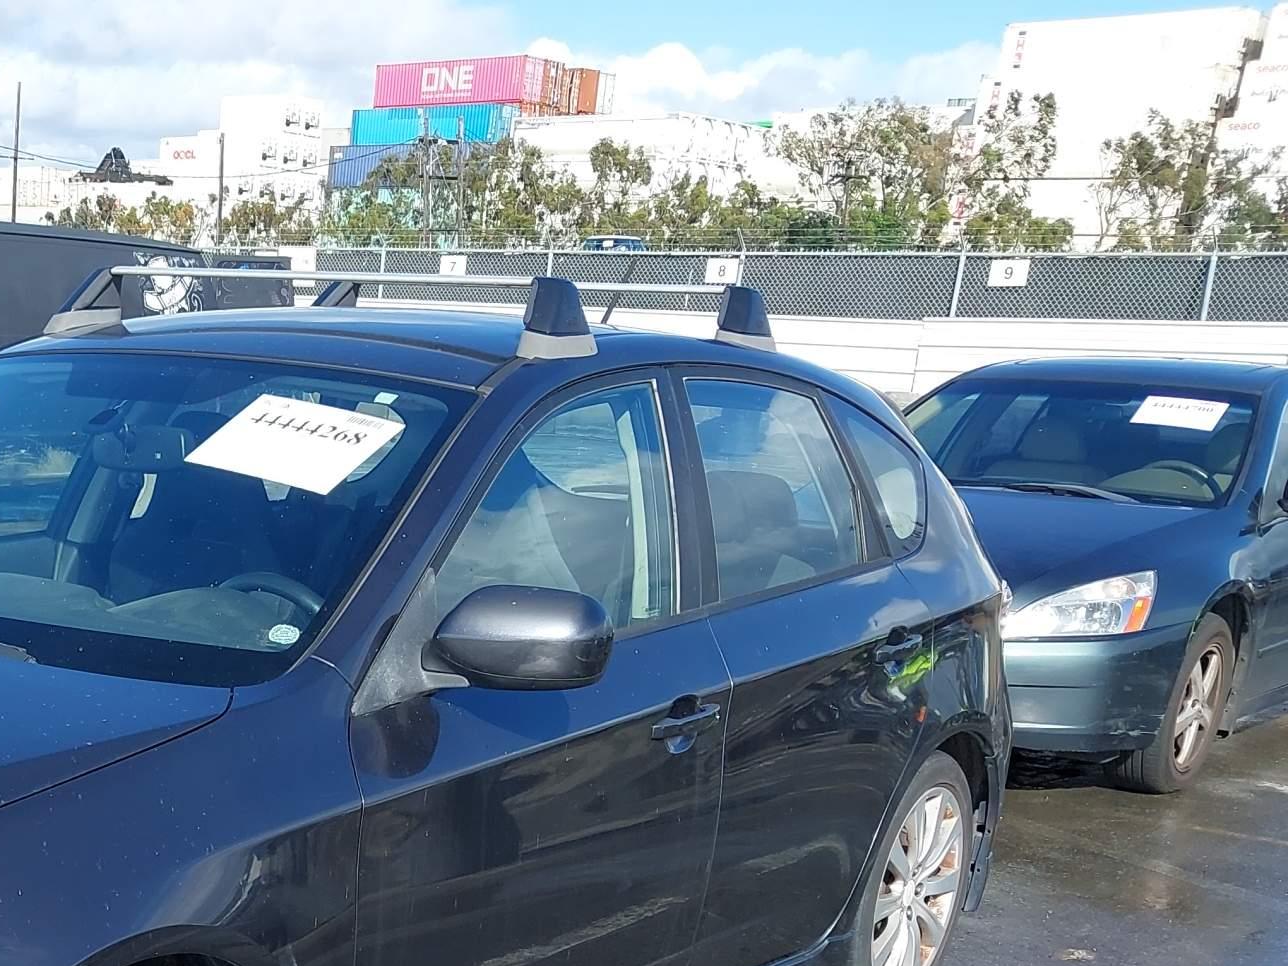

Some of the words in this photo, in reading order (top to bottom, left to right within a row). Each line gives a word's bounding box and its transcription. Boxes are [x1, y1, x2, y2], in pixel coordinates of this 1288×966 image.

[421, 64, 474, 92] ONE
[448, 261, 457, 272] 7
[718, 265, 726, 277] 8
[1004, 266, 1014, 280] 9
[250, 412, 368, 446] 44444268
